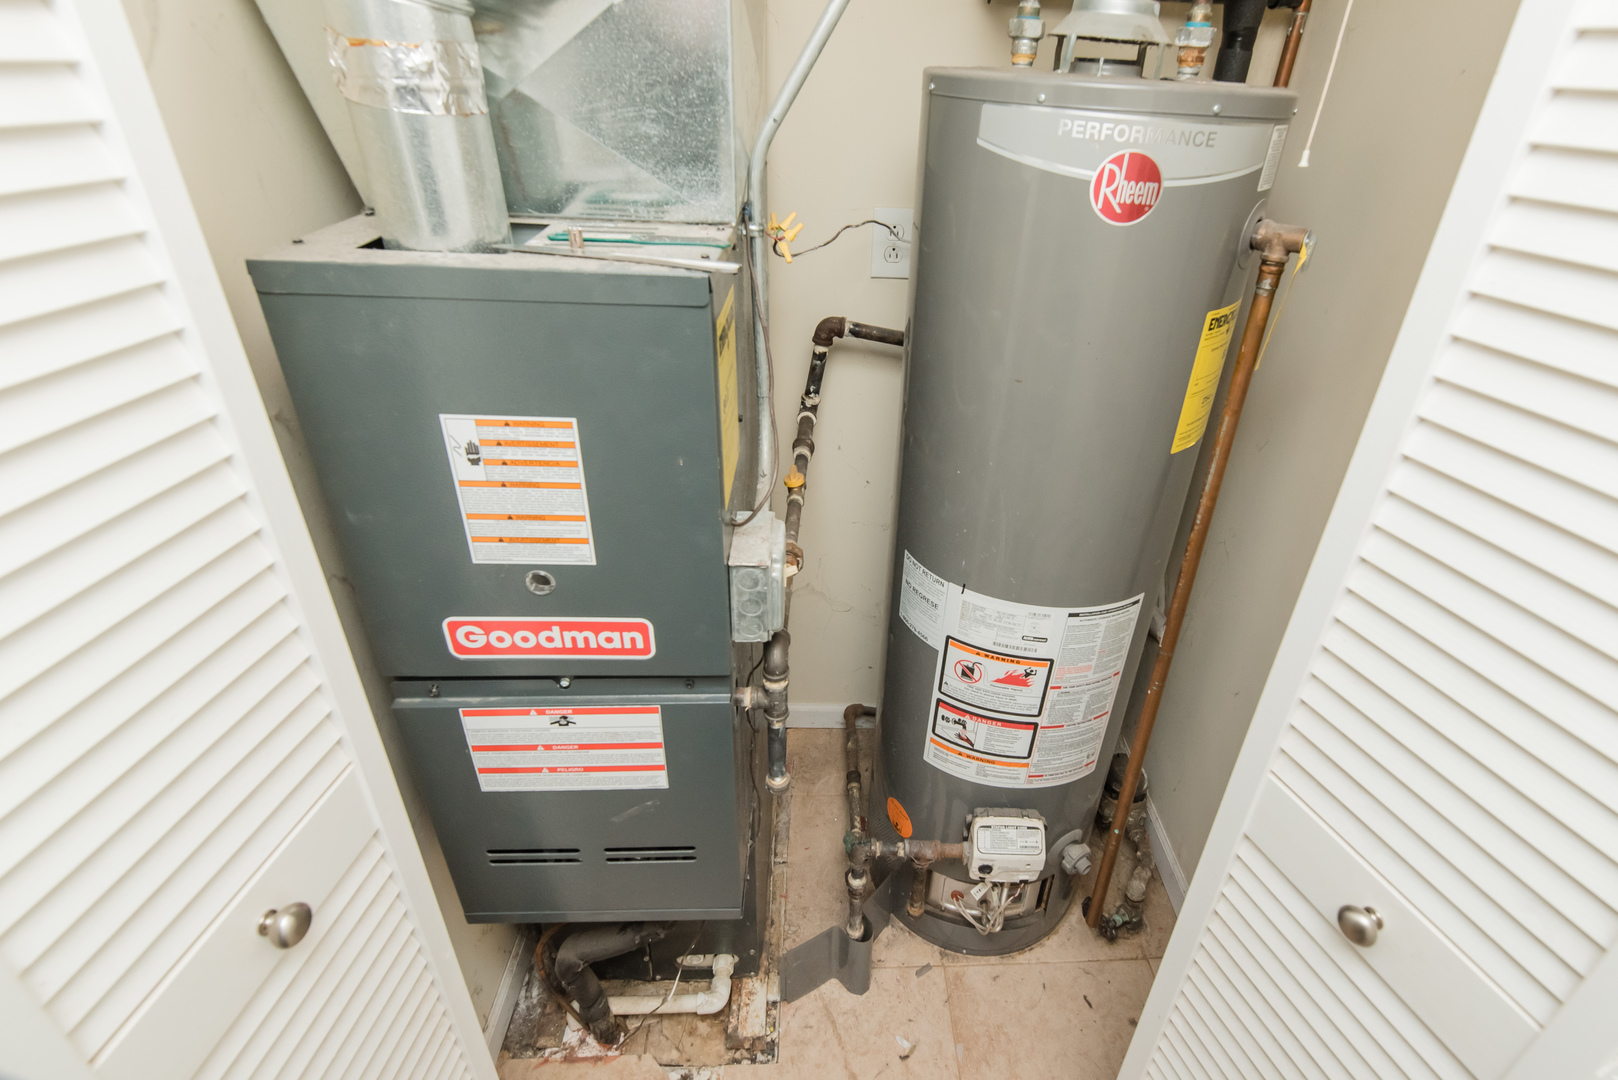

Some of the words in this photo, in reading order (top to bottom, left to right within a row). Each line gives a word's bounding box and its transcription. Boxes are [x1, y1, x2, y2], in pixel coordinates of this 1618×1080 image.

[1057, 118, 1218, 148] PERFORMANCE
[1098, 152, 1160, 214] Rheem
[509, 459, 561, 467] ADVERTENCIA
[905, 553, 912, 563] DO
[912, 559, 922, 572] NOT
[921, 568, 946, 588] RETURN
[905, 578, 913, 589] NO
[912, 585, 939, 611] REGRESE
[455, 625, 645, 649] Goodman
[984, 653, 1021, 664] WARNING
[972, 716, 1002, 727] DANGER
[966, 754, 996, 765] WARNING
